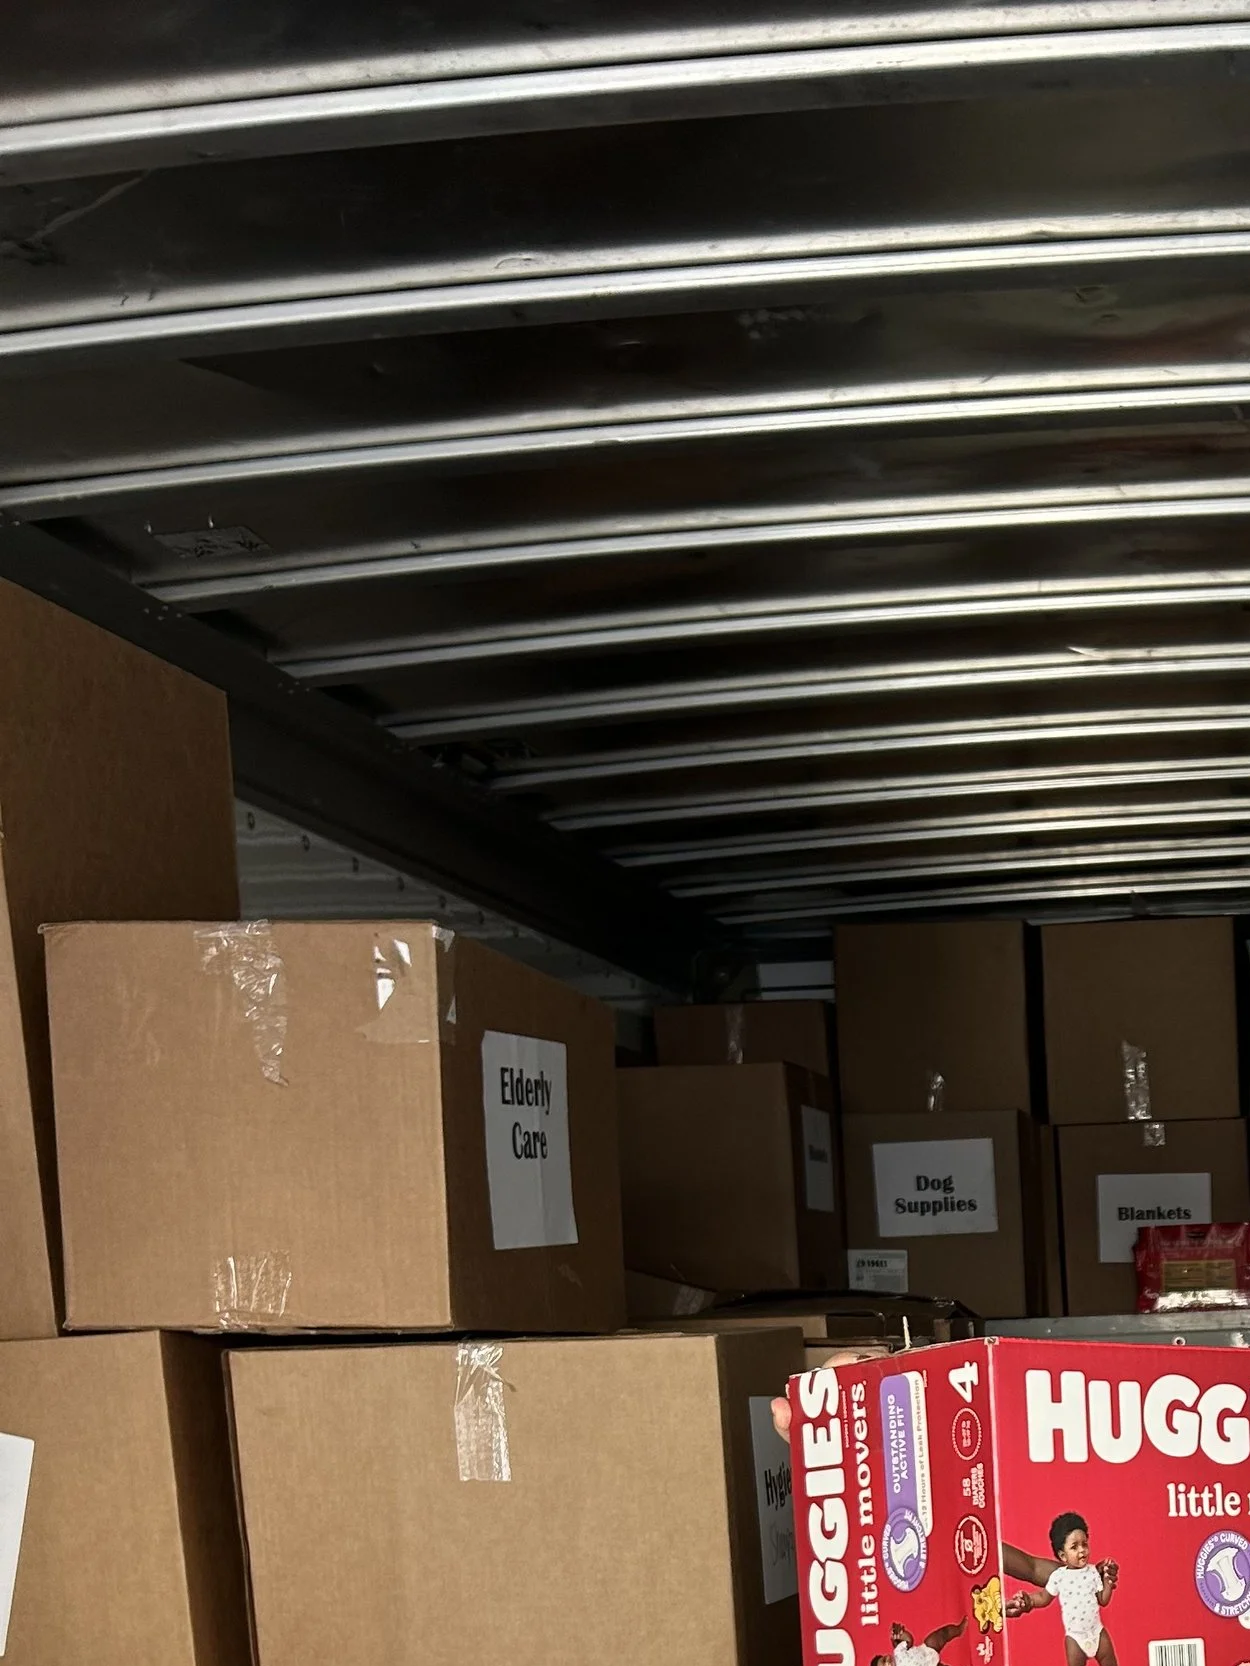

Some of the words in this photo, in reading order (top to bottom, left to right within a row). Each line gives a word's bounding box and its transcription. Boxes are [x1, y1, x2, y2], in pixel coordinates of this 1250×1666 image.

[500, 1066, 552, 1115] Elderly
[512, 1121, 548, 1159] Care
[915, 1174, 955, 1194] Dog
[894, 1196, 978, 1216] Supplies
[1117, 1204, 1192, 1223] Blankets
[948, 1361, 979, 1403] 4
[896, 1406, 905, 1428] FIT
[852, 1381, 875, 1526] movers
[887, 1394, 900, 1494] OUTSTANDING
[899, 1430, 909, 1480] ACTIVE
[764, 1462, 792, 1511] Hygie
[962, 1477, 971, 1497] 58
[976, 1462, 986, 1508] COUCHES
[1166, 1482, 1241, 1517] little
[1219, 1532, 1249, 1551] CURVED
[858, 1534, 879, 1627] little
